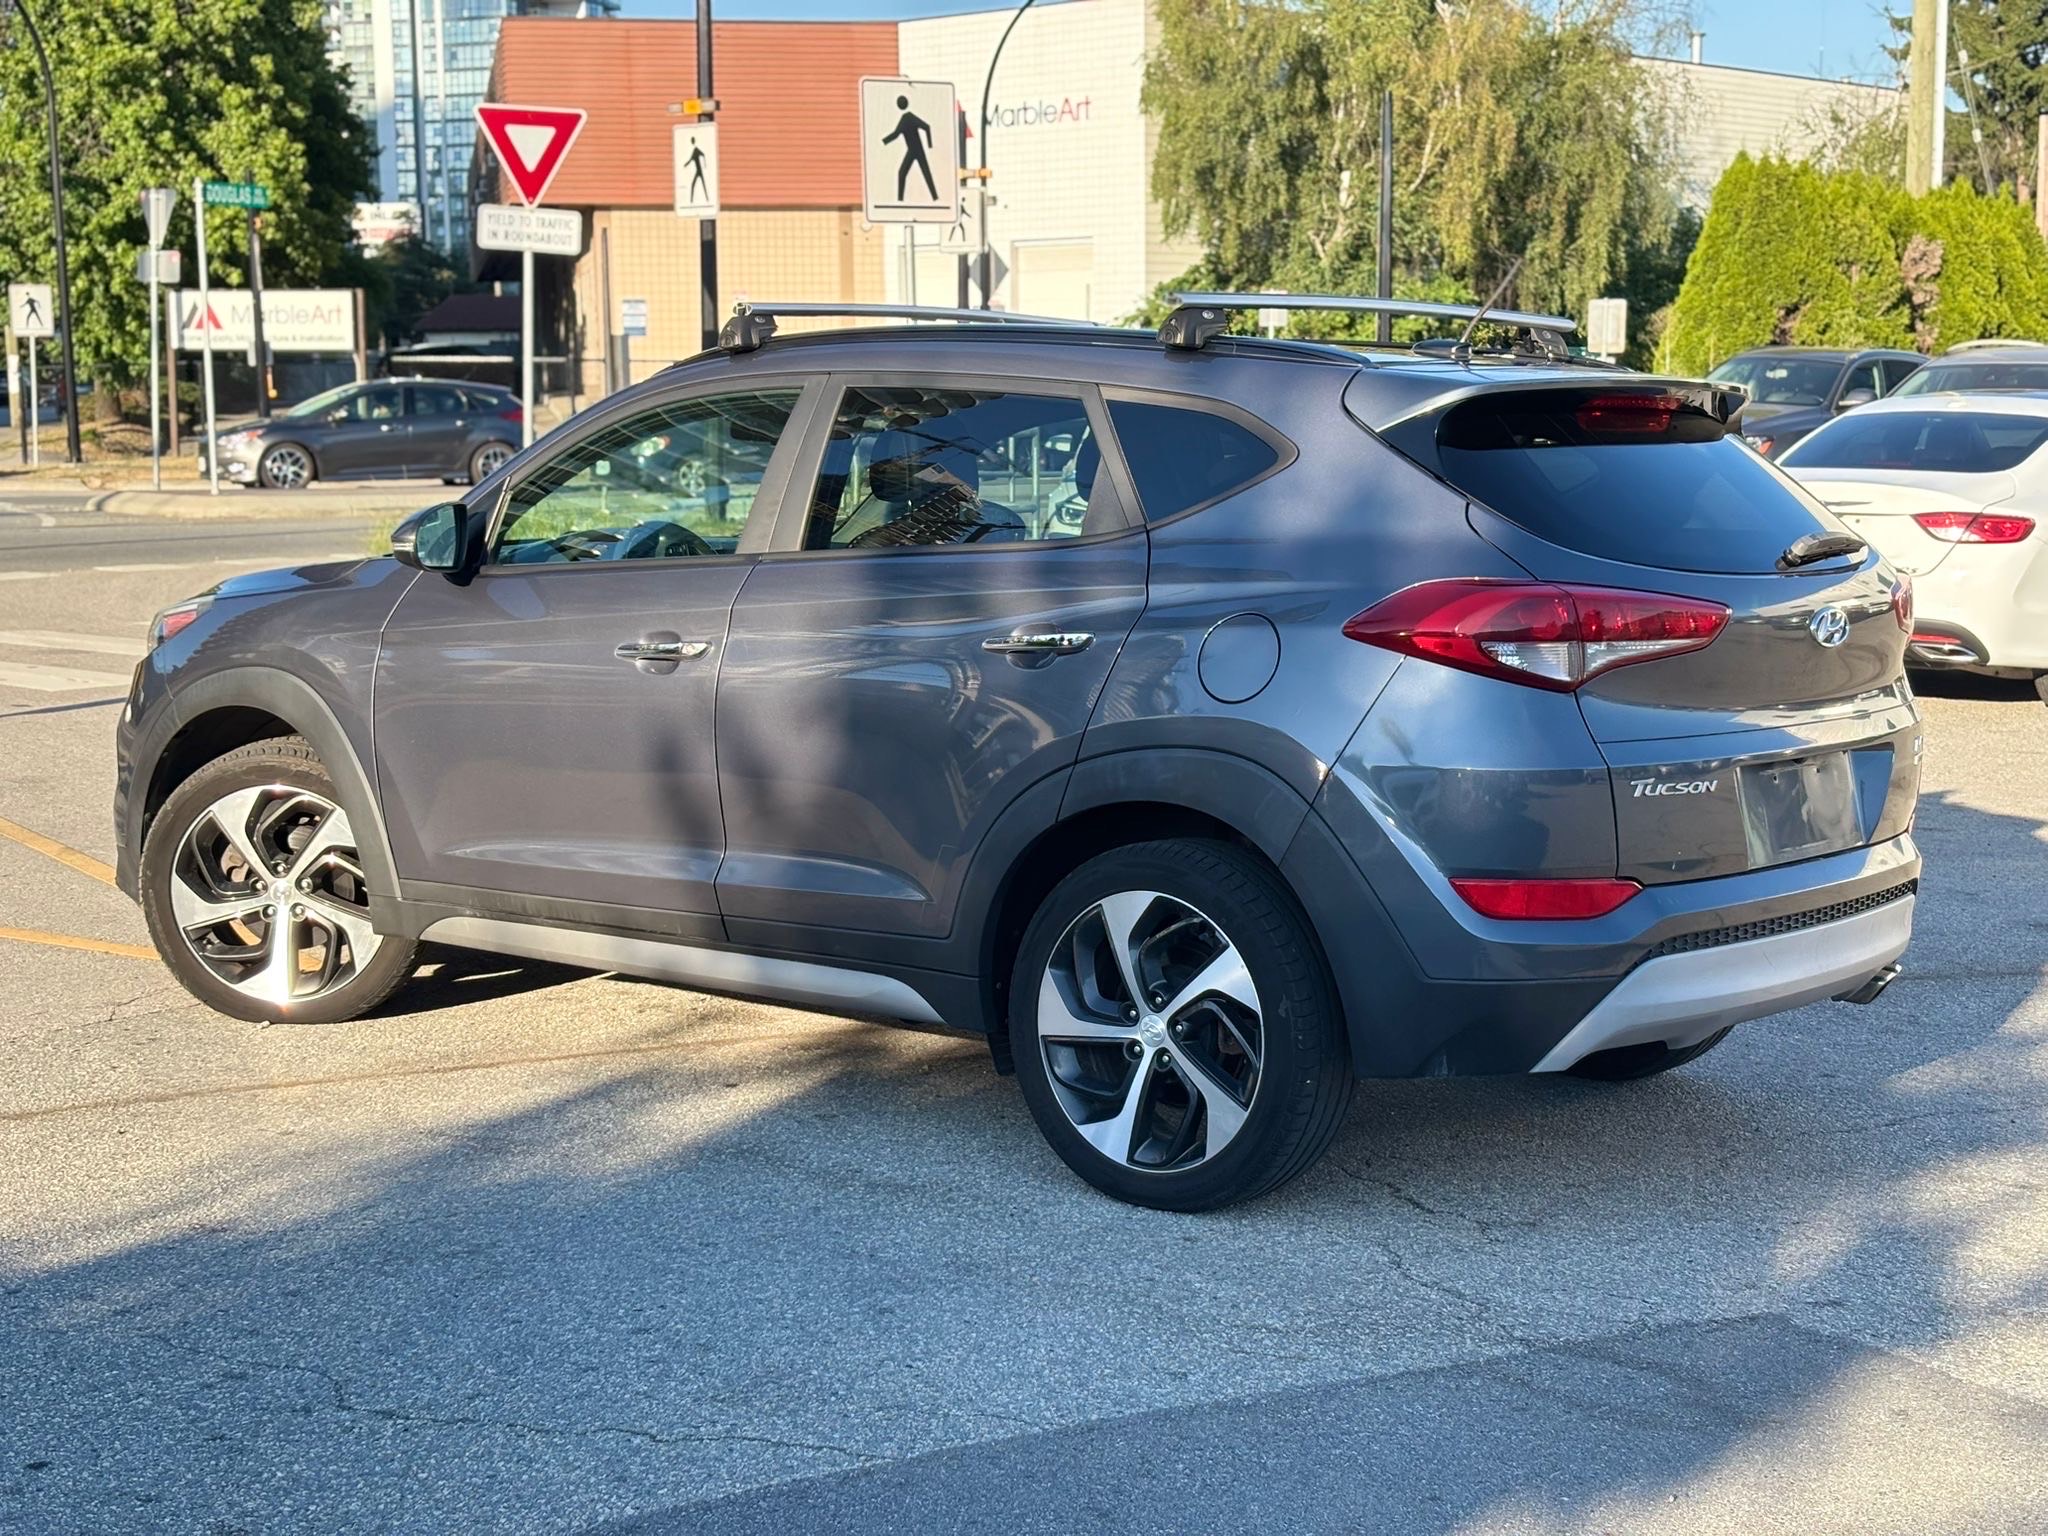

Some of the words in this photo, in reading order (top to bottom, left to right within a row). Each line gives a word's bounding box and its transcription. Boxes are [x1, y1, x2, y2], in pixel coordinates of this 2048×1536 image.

[206, 184, 251, 204] DOUGLAS
[487, 213, 515, 226] YIELD
[519, 215, 532, 228] TO
[535, 216, 574, 230] TRAFFIC
[487, 227, 499, 240] IN
[503, 229, 573, 246] ROUNDABOUT
[231, 304, 343, 325] MrbleArt
